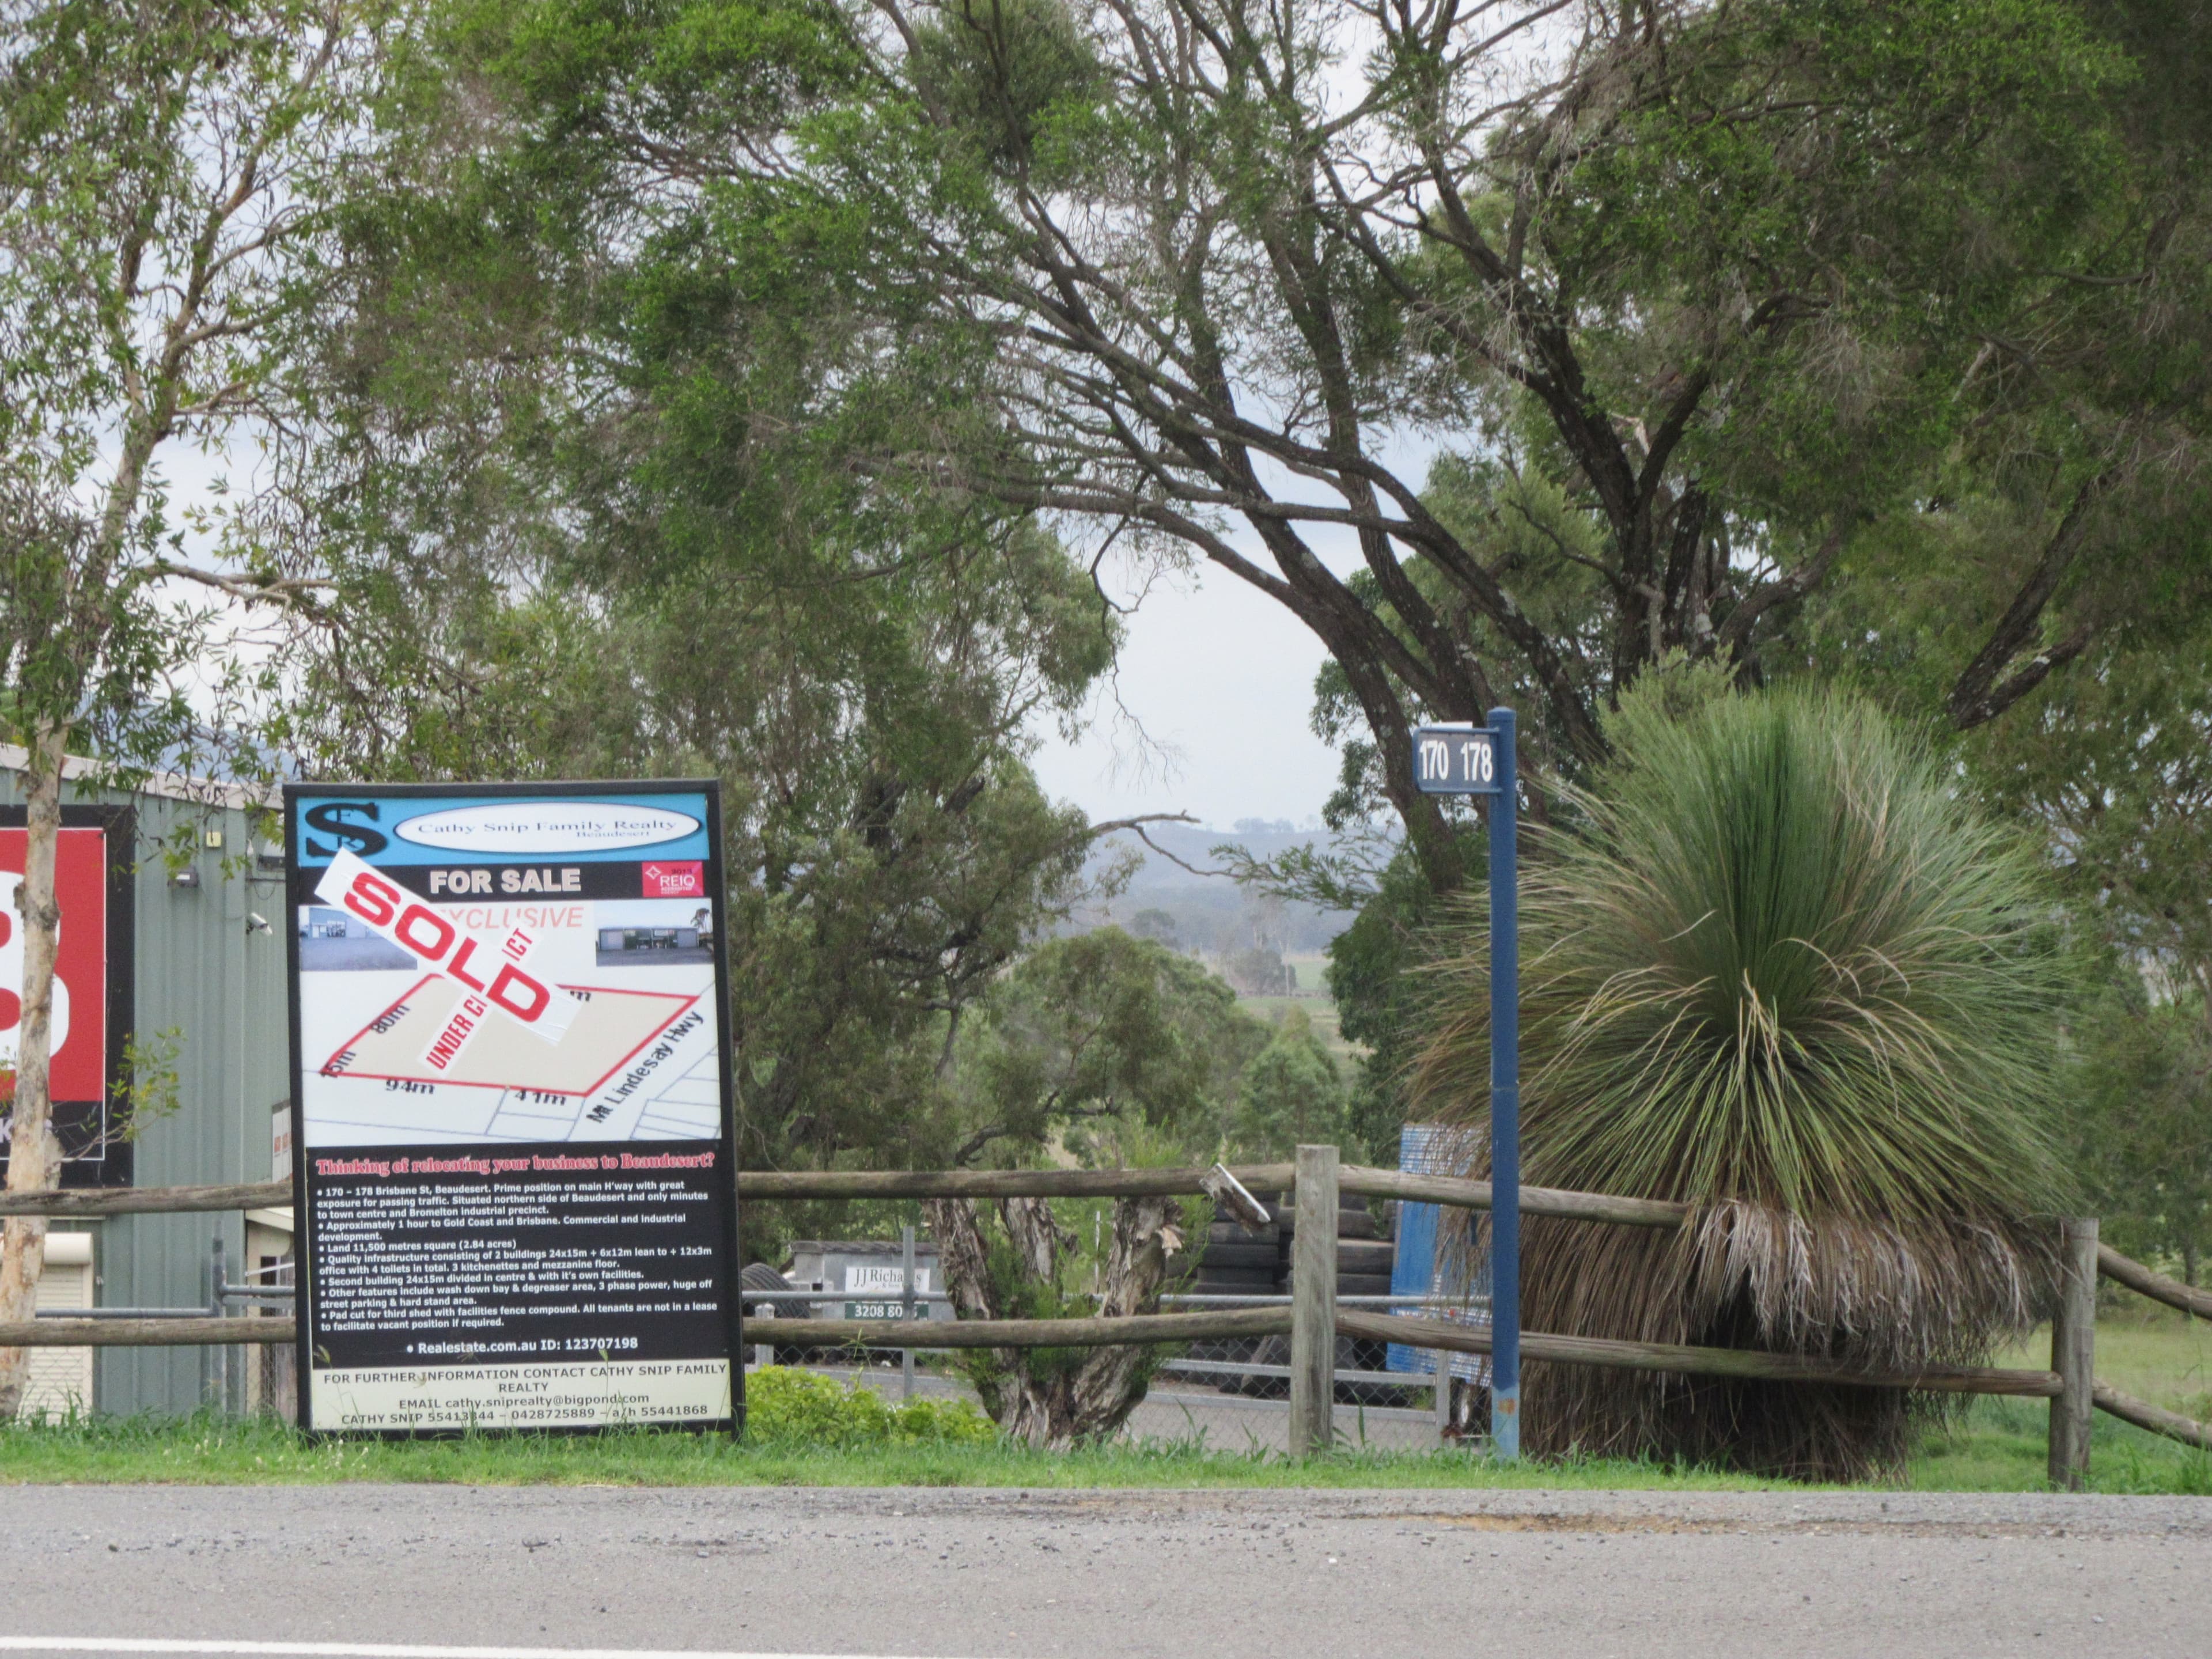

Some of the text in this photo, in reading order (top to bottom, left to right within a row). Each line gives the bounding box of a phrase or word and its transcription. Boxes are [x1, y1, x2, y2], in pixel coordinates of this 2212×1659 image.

[1419, 740, 1493, 782] 170 178
[418, 820, 676, 834] Cathy Snip Family Realty
[430, 868, 582, 893] FOR SALE
[440, 906, 585, 929] XCLUSIVE
[344, 872, 550, 1022] SOLD
[370, 1005, 410, 1034] 80m
[426, 1013, 475, 1070] UNDER
[586, 1010, 704, 1124] Mt Lindesay Hwy
[385, 1079, 435, 1094] 94m
[515, 1089, 566, 1105] 41m
[316, 1151, 715, 1177] Thinking relocating your business Beaudesert?
[325, 1187, 343, 1196] 170
[355, 1187, 373, 1195] 178
[375, 1185, 417, 1195] Brisbane
[419, 1185, 432, 1196] St,
[435, 1184, 491, 1194] Beaudesert.
[494, 1183, 521, 1192] Prime
[524, 1183, 561, 1194] position
[578, 1182, 601, 1191] main
[636, 1180, 657, 1190] with
[659, 1180, 684, 1191] great
[317, 1191, 707, 1210] exposure passing traffic. Situated northern side Beaudesert and only minutes
[329, 1206, 548, 1218] town centre and Bromelton industrial precinct.
[326, 1214, 685, 1232] Approximately hour Gold Coast and Brisbane. Commercial and industrial
[318, 1232, 382, 1243] development.
[327, 1240, 516, 1253] Land 11,500 metres square (2.84 acres)
[327, 1247, 711, 1265] Quality infrastructure consisting buildings 24x15m 6x12m lean 12x3m
[319, 1260, 619, 1274] office with toilets total. kitchenettes and mezzanine floor.
[870, 1268, 922, 1282] Richas
[328, 1277, 362, 1285] Second
[365, 1276, 403, 1287] building
[406, 1275, 444, 1283] 24x15m
[446, 1274, 481, 1282] divided
[495, 1273, 525, 1282] centre
[538, 1272, 559, 1281] with
[562, 1272, 576, 1280] it's
[601, 1271, 643, 1279] facilities.
[328, 1280, 712, 1297] Other features include wash down bay degreaser area, phase power, huge off
[320, 1300, 349, 1308] street
[351, 1299, 387, 1309] parking
[399, 1298, 421, 1306] hard
[423, 1297, 450, 1305] stand
[329, 1311, 347, 1319] Pad
[350, 1310, 365, 1319] cut
[383, 1309, 406, 1317] third
[409, 1309, 431, 1317] shed
[434, 1308, 454, 1316] with
[457, 1308, 497, 1316] facilities
[500, 1307, 526, 1315] fence
[528, 1306, 579, 1316] compound.
[583, 1305, 595, 1313] All
[598, 1304, 634, 1313] tenants
[654, 1304, 669, 1312] not
[692, 1302, 717, 1310] lease
[855, 1305, 918, 1318] 3208 80
[333, 1319, 504, 1331] facilitate vacant position required.
[418, 1338, 638, 1354] Realestate.com.au ID: 123707198
[324, 1364, 726, 1384] FOR FURTHER INFORMATION CONTACT CATHY SNIP FAMILY
[499, 1382, 548, 1392] REALTY
[399, 1398, 440, 1408] EMAIL
[342, 1412, 384, 1423] CATHY
[390, 1412, 422, 1422] SNIP
[511, 1408, 594, 1419] 0428725889
[641, 1405, 707, 1416] 55441868
